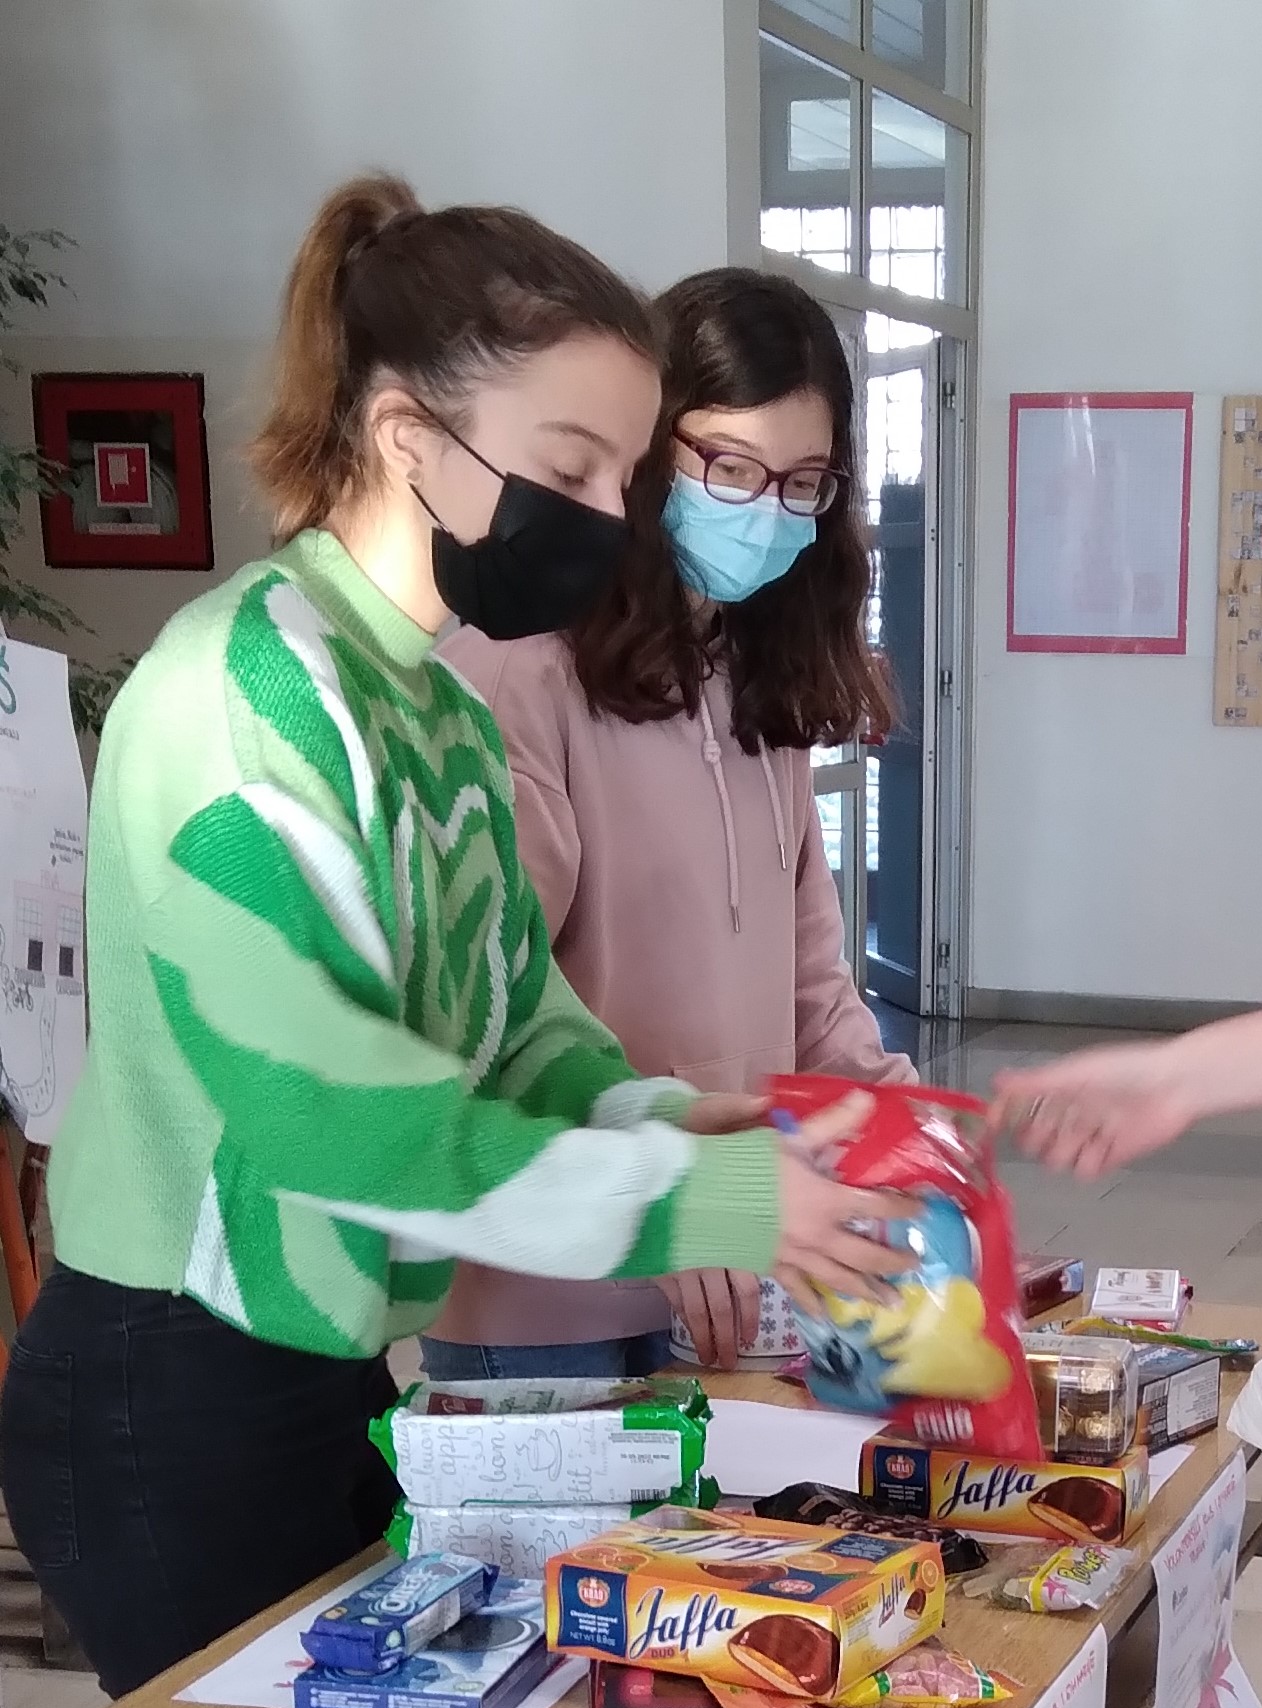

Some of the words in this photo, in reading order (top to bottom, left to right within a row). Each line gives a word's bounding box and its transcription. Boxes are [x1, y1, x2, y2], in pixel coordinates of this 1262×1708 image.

[937, 1461, 1038, 1520] Jaffa
[1057, 1546, 1104, 1586] Powe
[628, 1586, 740, 1660] Jaffa
[878, 1572, 906, 1628] Jaffa
[651, 1648, 675, 1659] DUO
